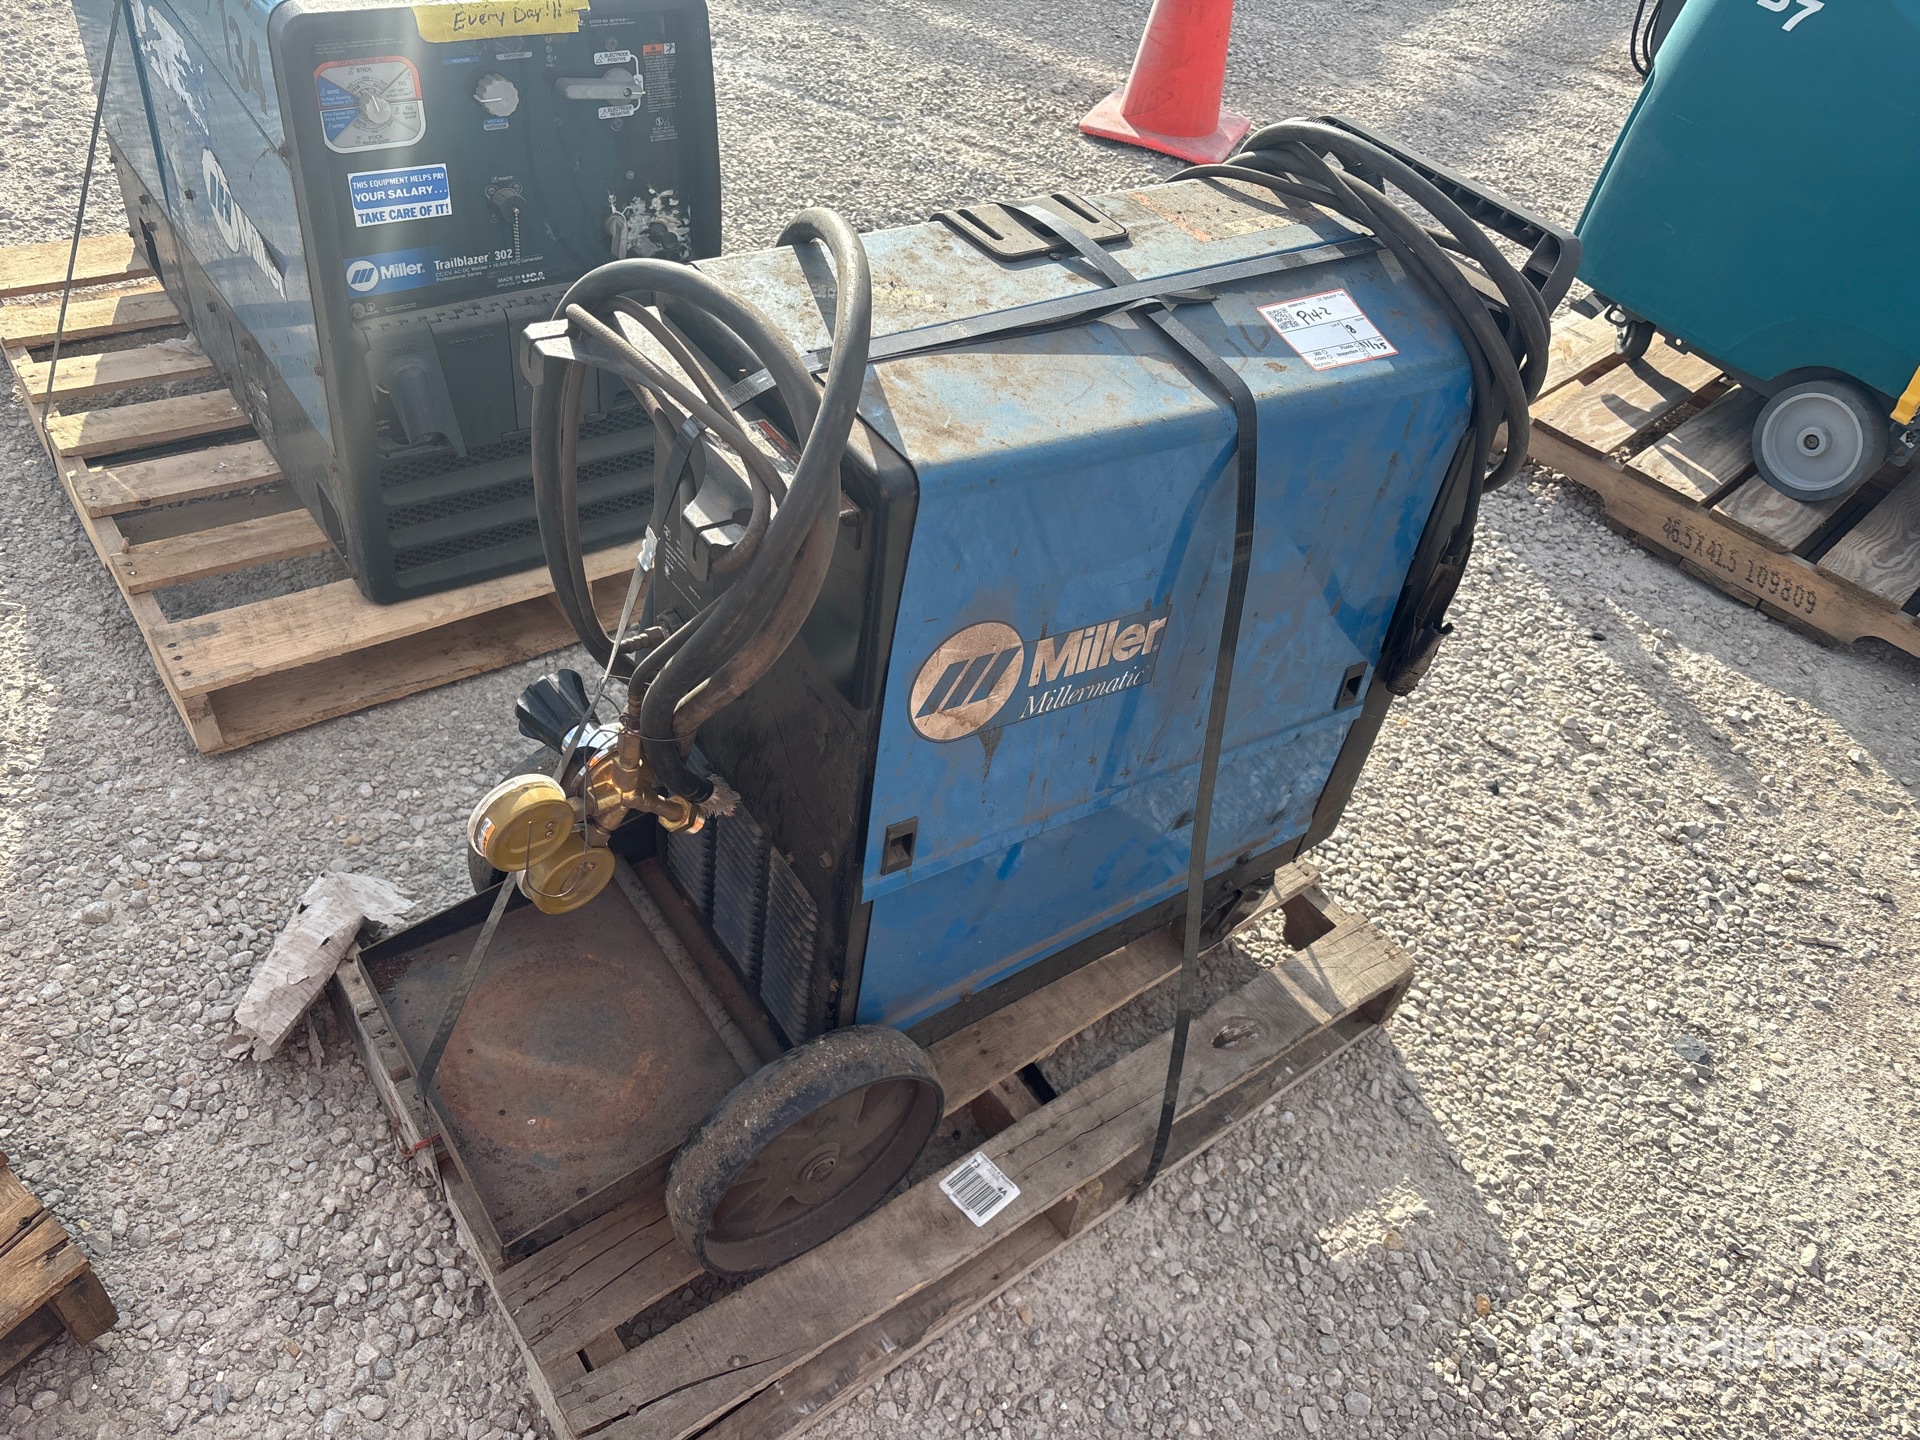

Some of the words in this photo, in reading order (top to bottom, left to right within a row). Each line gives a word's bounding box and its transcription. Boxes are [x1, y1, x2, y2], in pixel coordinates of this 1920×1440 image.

[452, 10, 505, 32] Every
[352, 182, 369, 190] THIS
[370, 176, 409, 188] EQUIPMENT
[410, 173, 432, 183] HELPS
[432, 172, 445, 180] PAY
[354, 190, 386, 203] YOUR
[358, 210, 387, 225] TAKE
[388, 207, 416, 220] CARE
[419, 205, 433, 216] OF
[435, 203, 449, 215] IT!
[433, 253, 489, 271] Trailblazer
[494, 248, 513, 261] 302
[471, 264, 488, 273] Welder
[520, 254, 544, 264] Generator
[380, 262, 423, 280] Miller
[435, 273, 467, 283] Professional
[466, 270, 482, 278] Series
[498, 275, 513, 283] MADE
[521, 271, 546, 283] USA
[1296, 306, 1332, 326] P14-2
[1345, 324, 1357, 335] 8
[1336, 349, 1359, 357] Inspection
[1745, 559, 1818, 614] 109809
[1028, 617, 1168, 688] Miller
[1019, 666, 1145, 720] Millermatic
